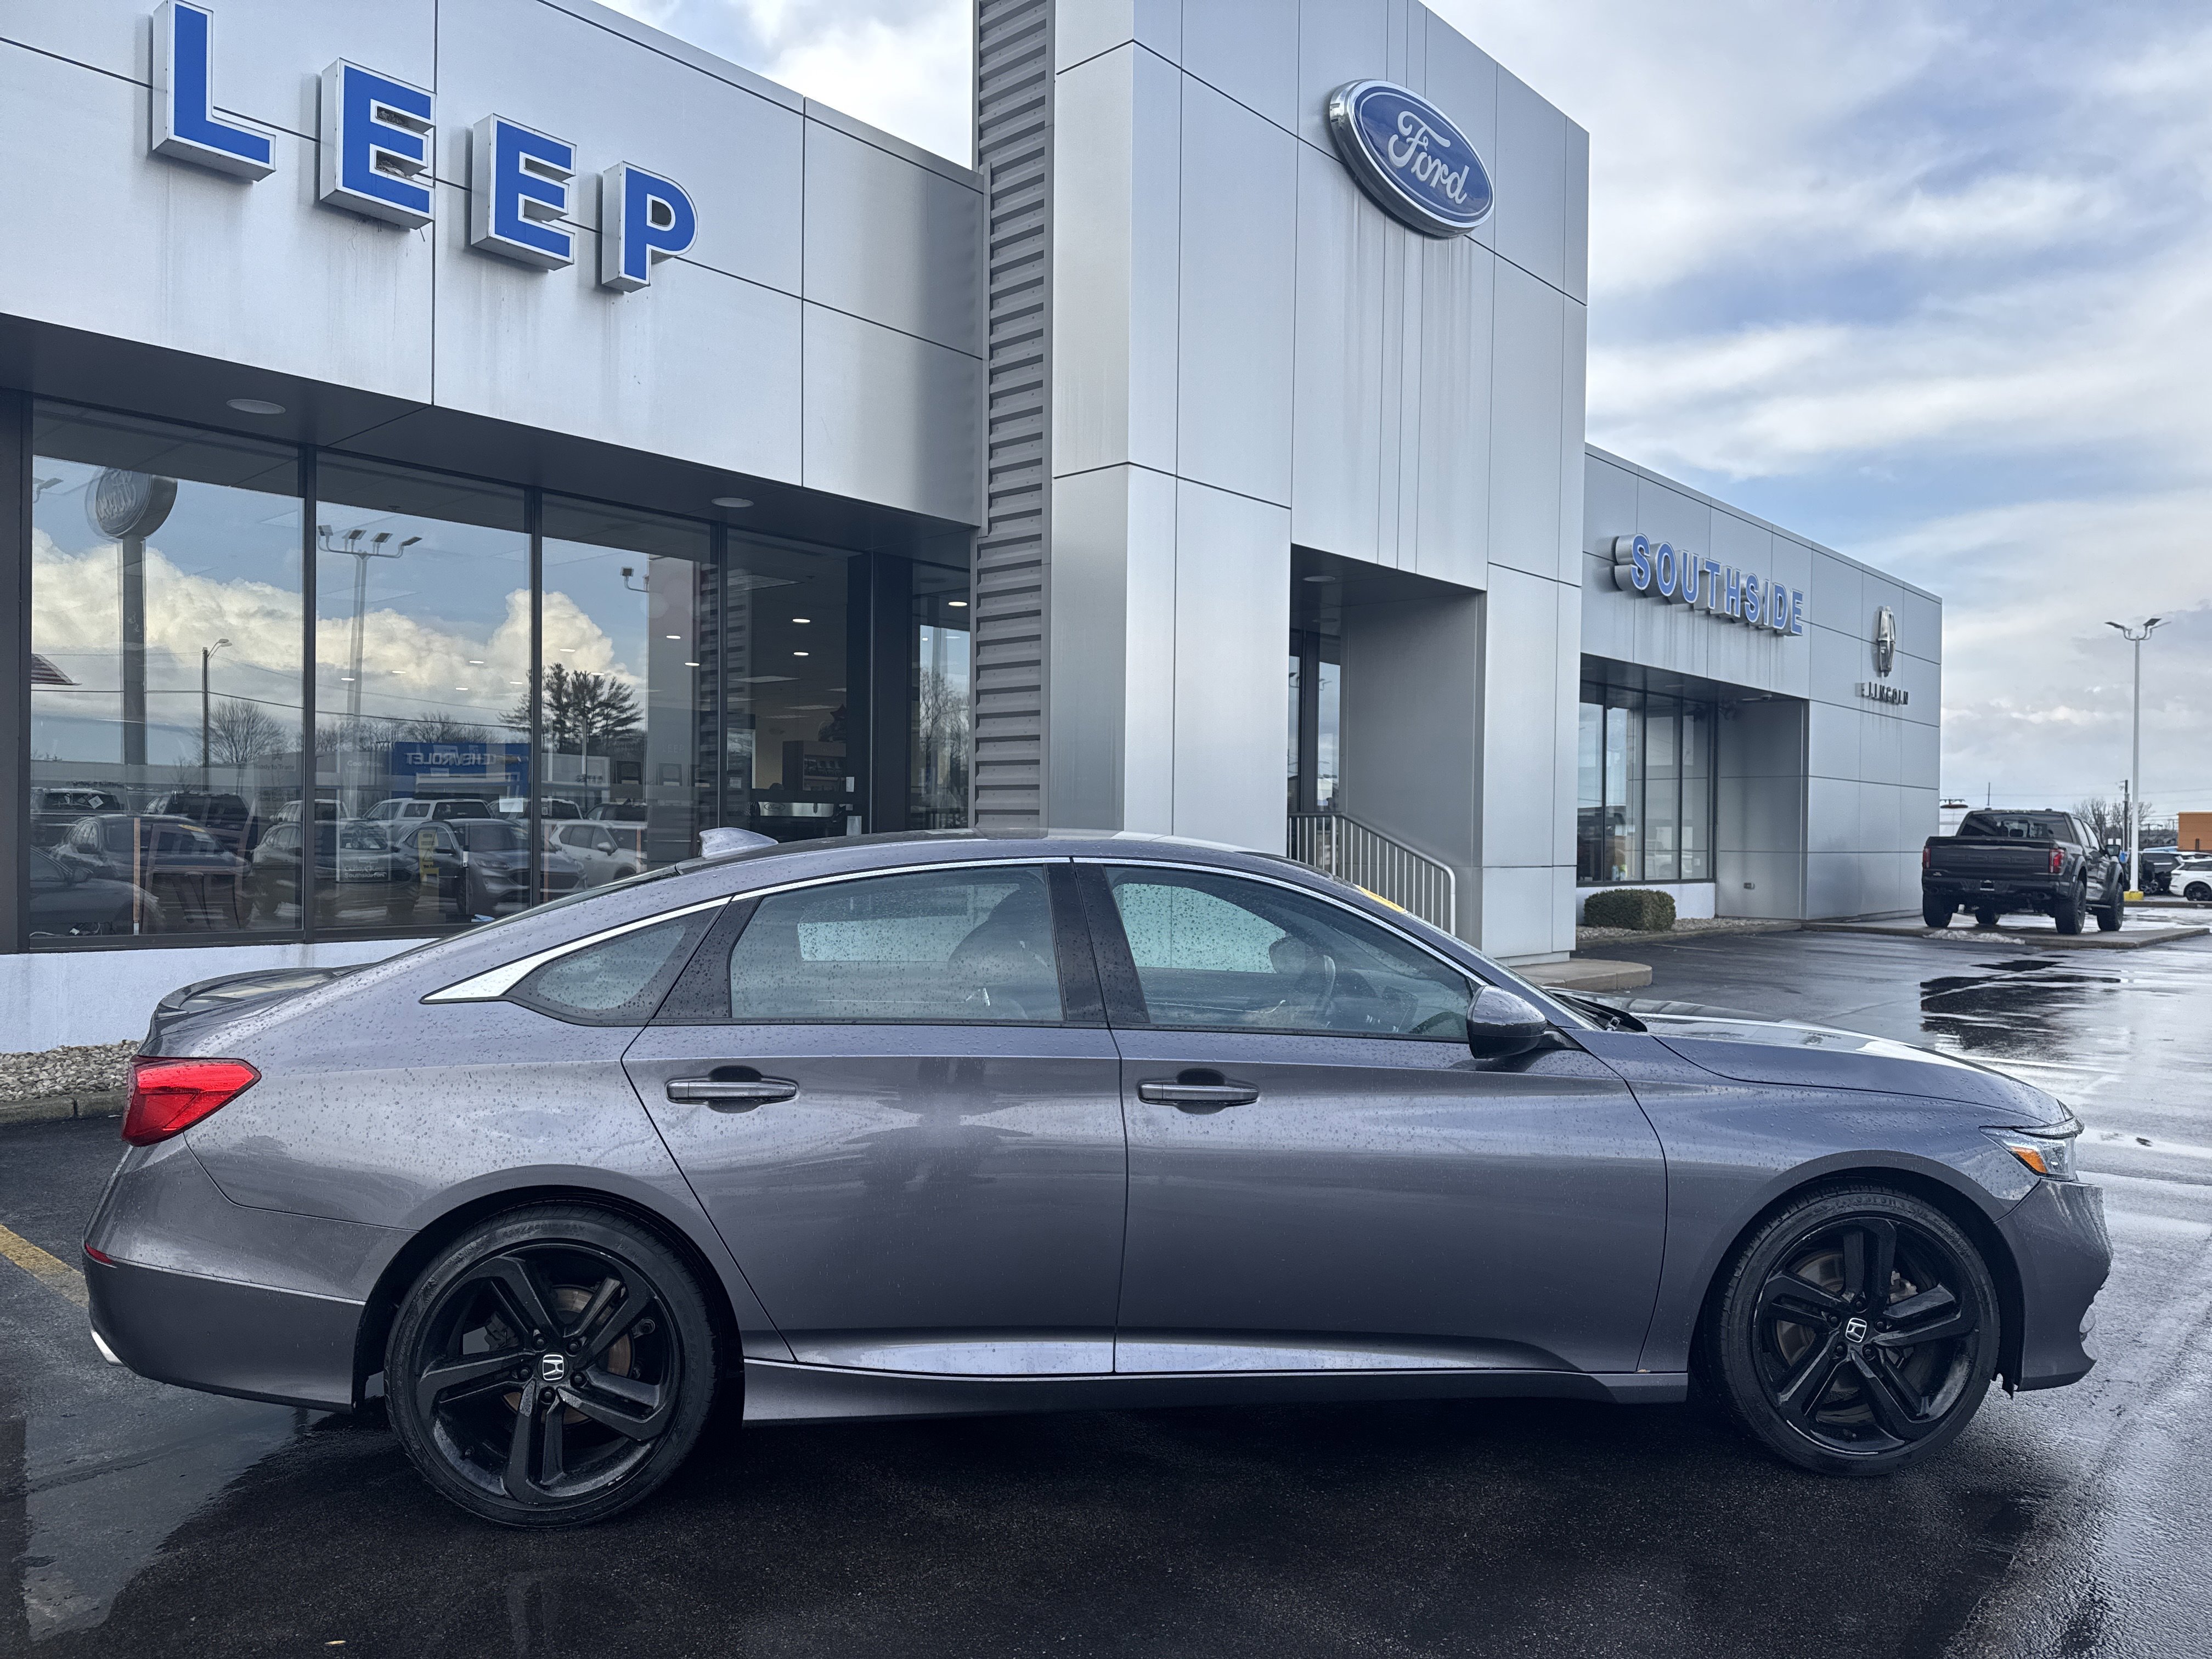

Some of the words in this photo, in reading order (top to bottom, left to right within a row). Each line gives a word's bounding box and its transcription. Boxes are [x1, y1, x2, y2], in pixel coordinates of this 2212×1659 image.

[162, 0, 698, 290] LEEP
[1387, 110, 1470, 205] Ford
[1628, 533, 1804, 636] SOUTHSIDE
[1868, 681, 1909, 706] LINCOLN
